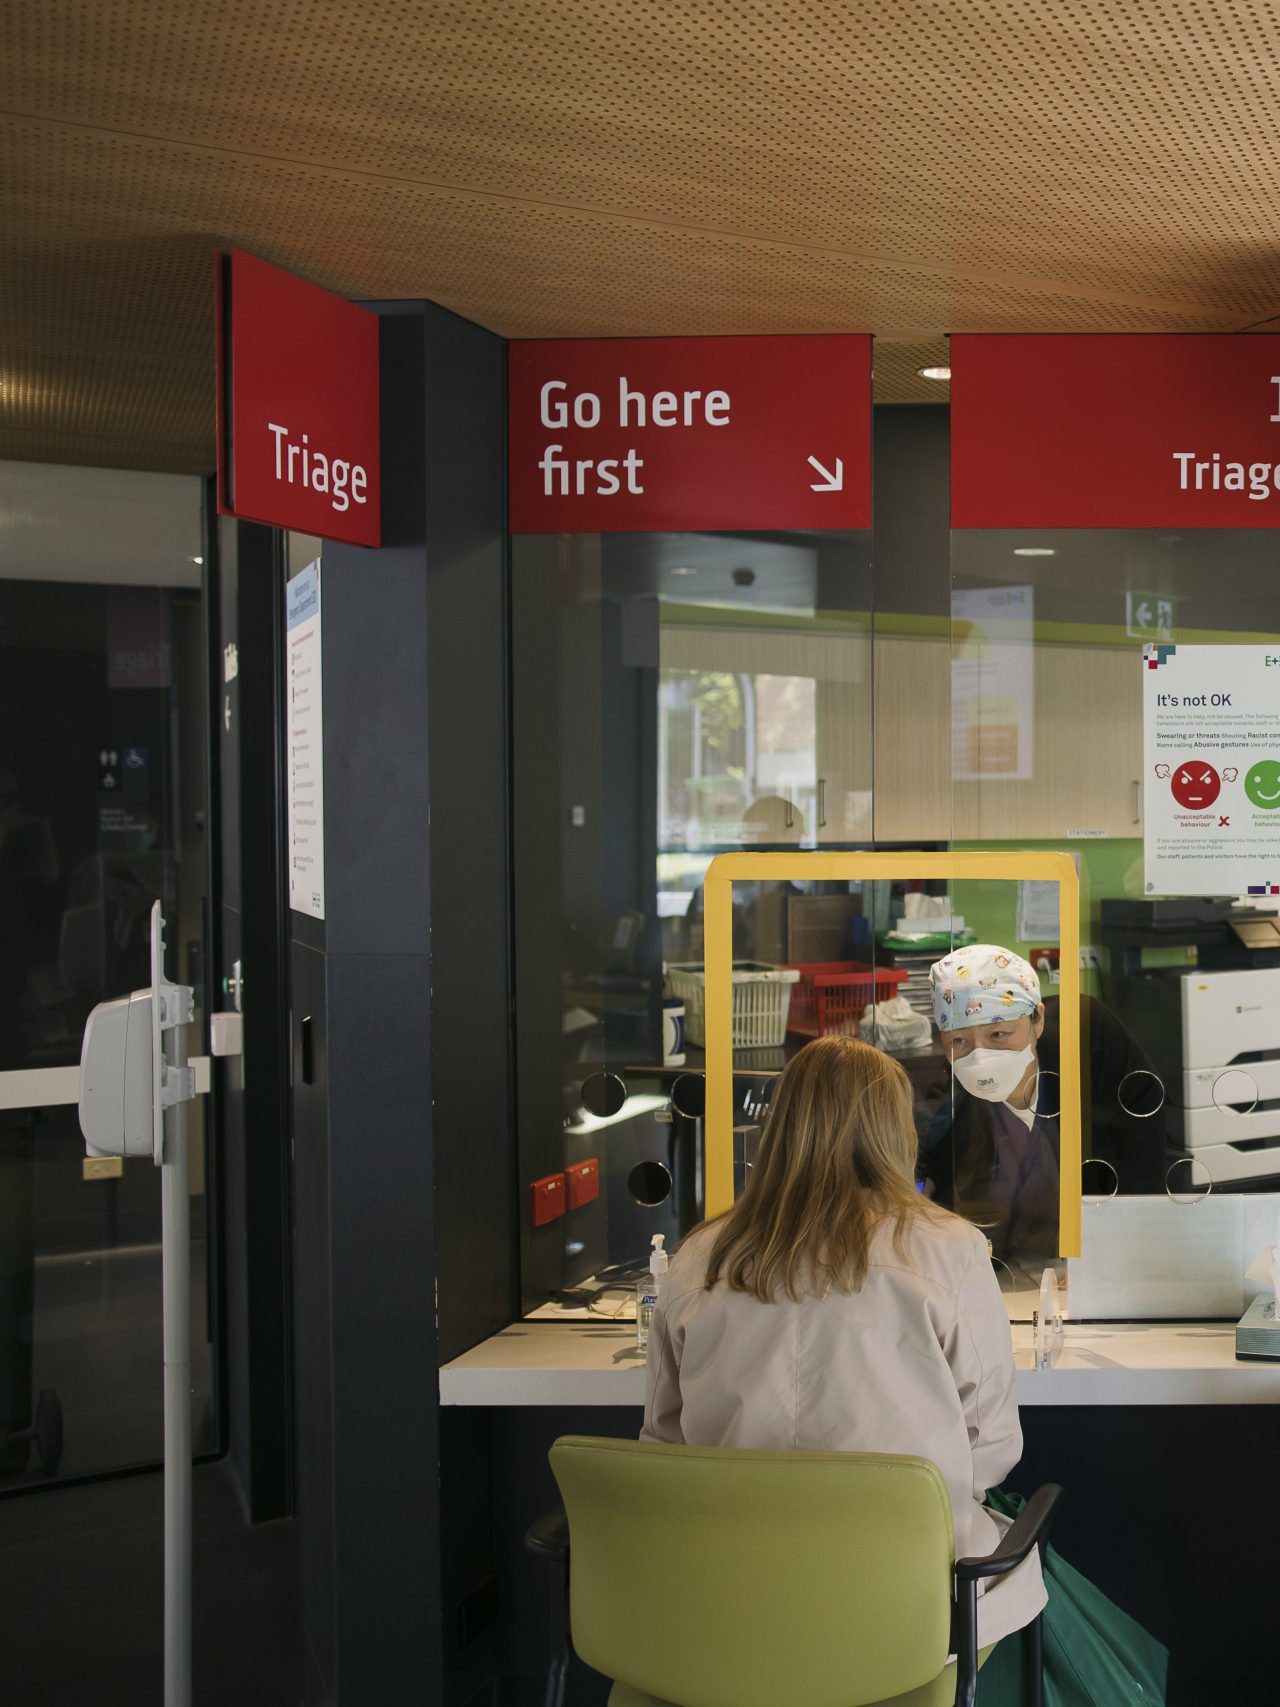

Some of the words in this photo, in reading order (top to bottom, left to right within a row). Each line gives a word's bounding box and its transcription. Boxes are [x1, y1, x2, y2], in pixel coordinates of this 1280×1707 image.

[540, 380, 601, 429] Go
[619, 376, 731, 427] here
[268, 421, 368, 512] Triage
[538, 444, 644, 496] first
[1183, 695, 1207, 707] not
[1211, 694, 1232, 707] OK
[1156, 741, 1173, 749] Name
[1174, 741, 1193, 749] calling
[1194, 741, 1219, 749] Abusive
[1220, 741, 1249, 749] gestures
[1250, 741, 1260, 749] Use
[1261, 741, 1268, 749] of
[1173, 813, 1216, 821] Unacceptable
[977, 1077, 995, 1087] 3M
